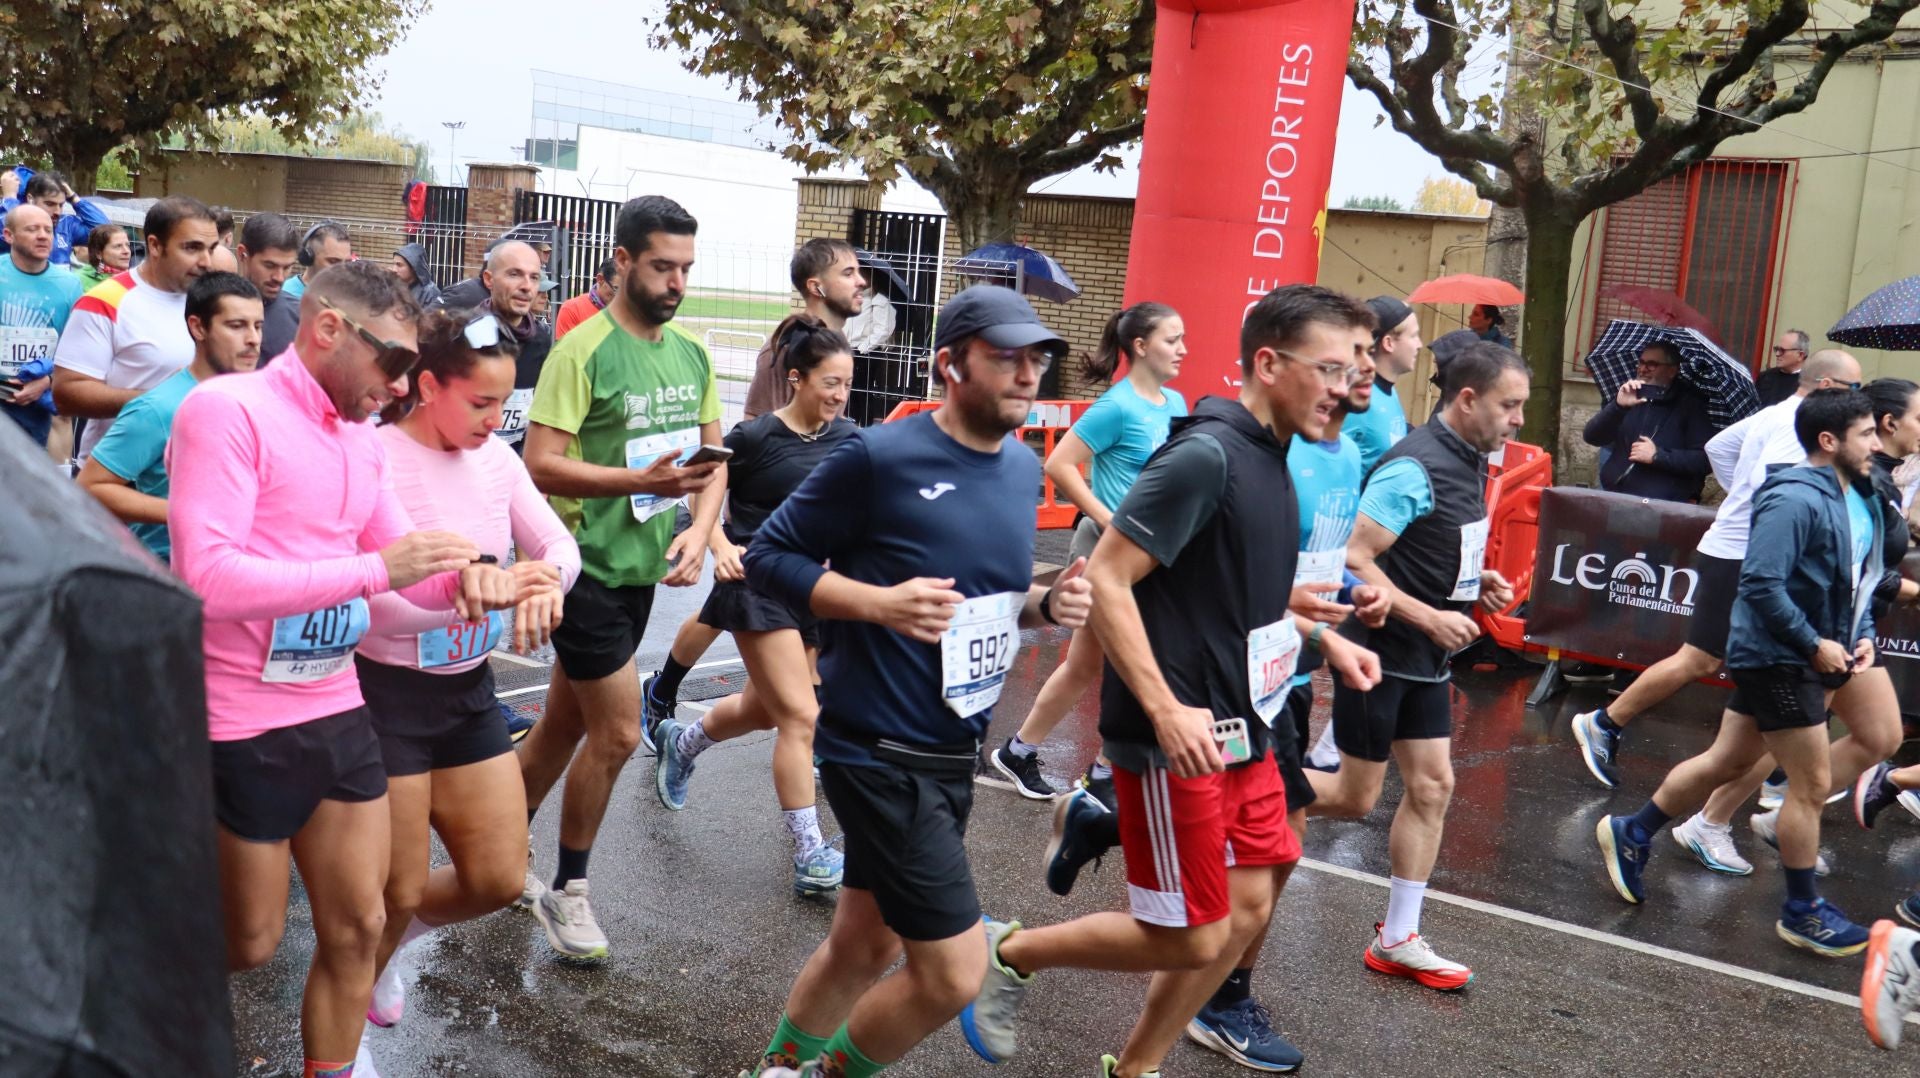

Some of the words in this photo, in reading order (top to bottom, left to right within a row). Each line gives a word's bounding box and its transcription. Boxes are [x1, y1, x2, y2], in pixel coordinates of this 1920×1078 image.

[1252, 43, 1314, 259] DEPORTES
[12, 343, 48, 362] 1043
[655, 385, 698, 404] aecc
[1609, 580, 1637, 595] Cuna
[1639, 585, 1656, 598] del
[300, 604, 351, 648] 407
[447, 615, 490, 661] 377
[969, 632, 1008, 680] 992
